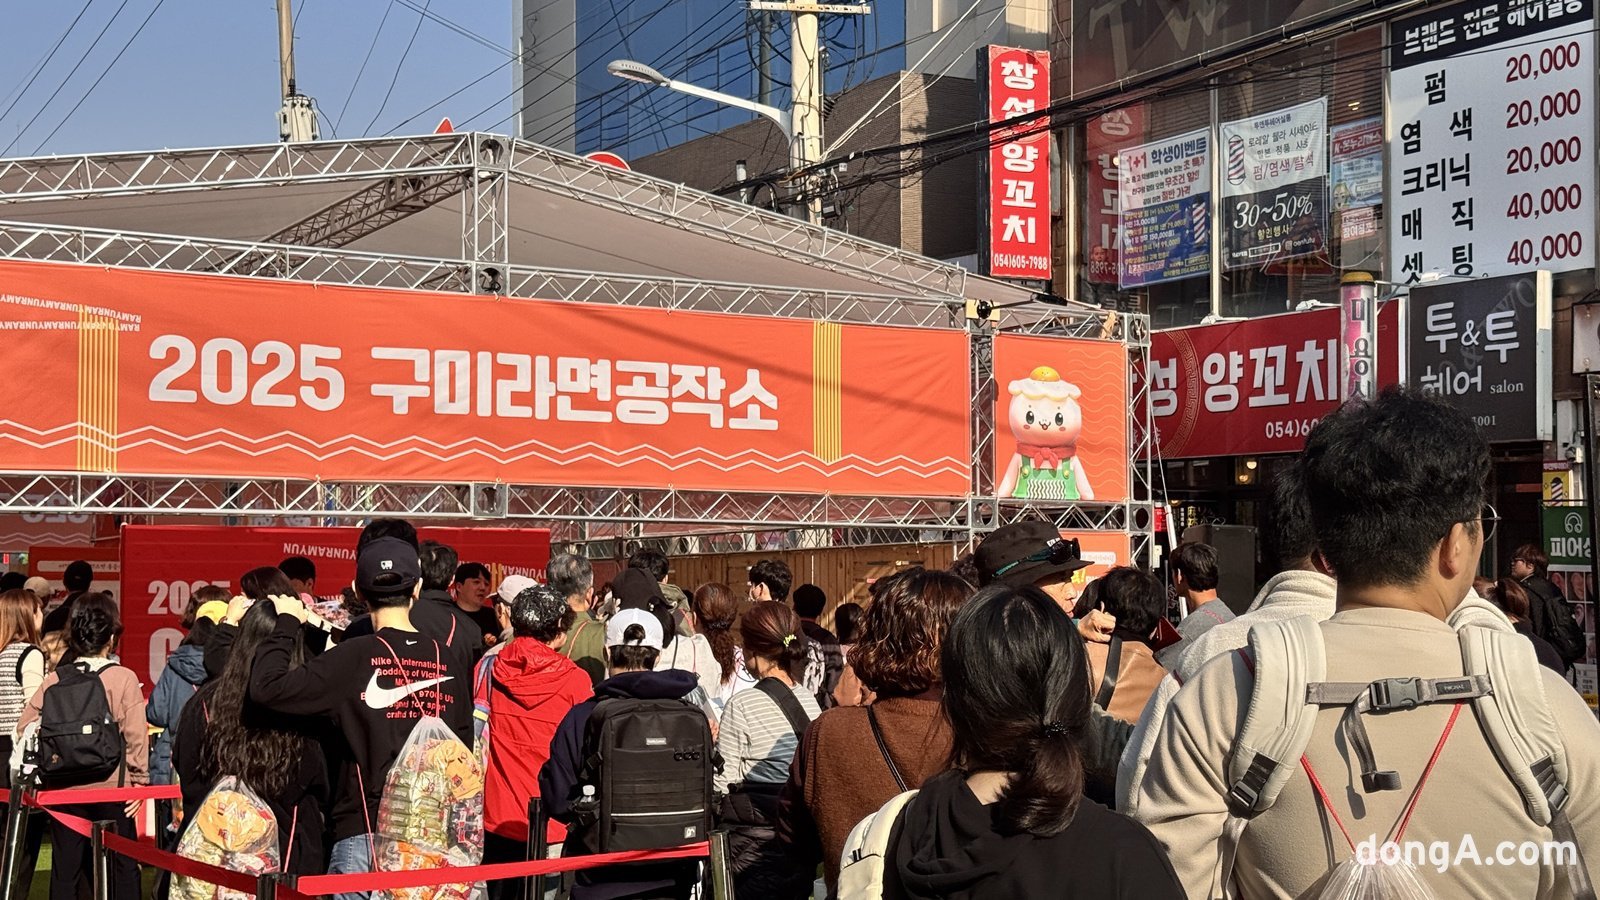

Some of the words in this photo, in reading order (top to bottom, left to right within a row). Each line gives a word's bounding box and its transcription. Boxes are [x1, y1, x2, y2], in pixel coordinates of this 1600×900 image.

[1404, 18, 1456, 55] 브랜드
[1463, 4, 1500, 41] 전문
[1424, 69, 1446, 105] 펌
[1506, 42, 1580, 82] 20,000
[1506, 88, 1581, 128] 20,000
[1151, 137, 1206, 164] 학생이벤트
[1248, 134, 1270, 148] 로레알
[1276, 143, 1290, 156] 정품
[1402, 153, 1470, 196] 크리닉
[1506, 136, 1581, 174] 20,000
[1234, 192, 1314, 229] 30~50%
[1506, 184, 1582, 220] 40,000
[1257, 224, 1290, 240] 할인행사
[1507, 231, 1582, 266] 40,000
[994, 255, 1048, 270] 054)605-7988
[149, 334, 345, 411] 2025
[370, 346, 778, 431] 구미라면공작소
[1132, 357, 1178, 416] 성
[1202, 338, 1338, 413] 양꼬치
[1421, 365, 1482, 396] 헤어
[1490, 379, 1524, 394] salon
[148, 580, 230, 615] 20
